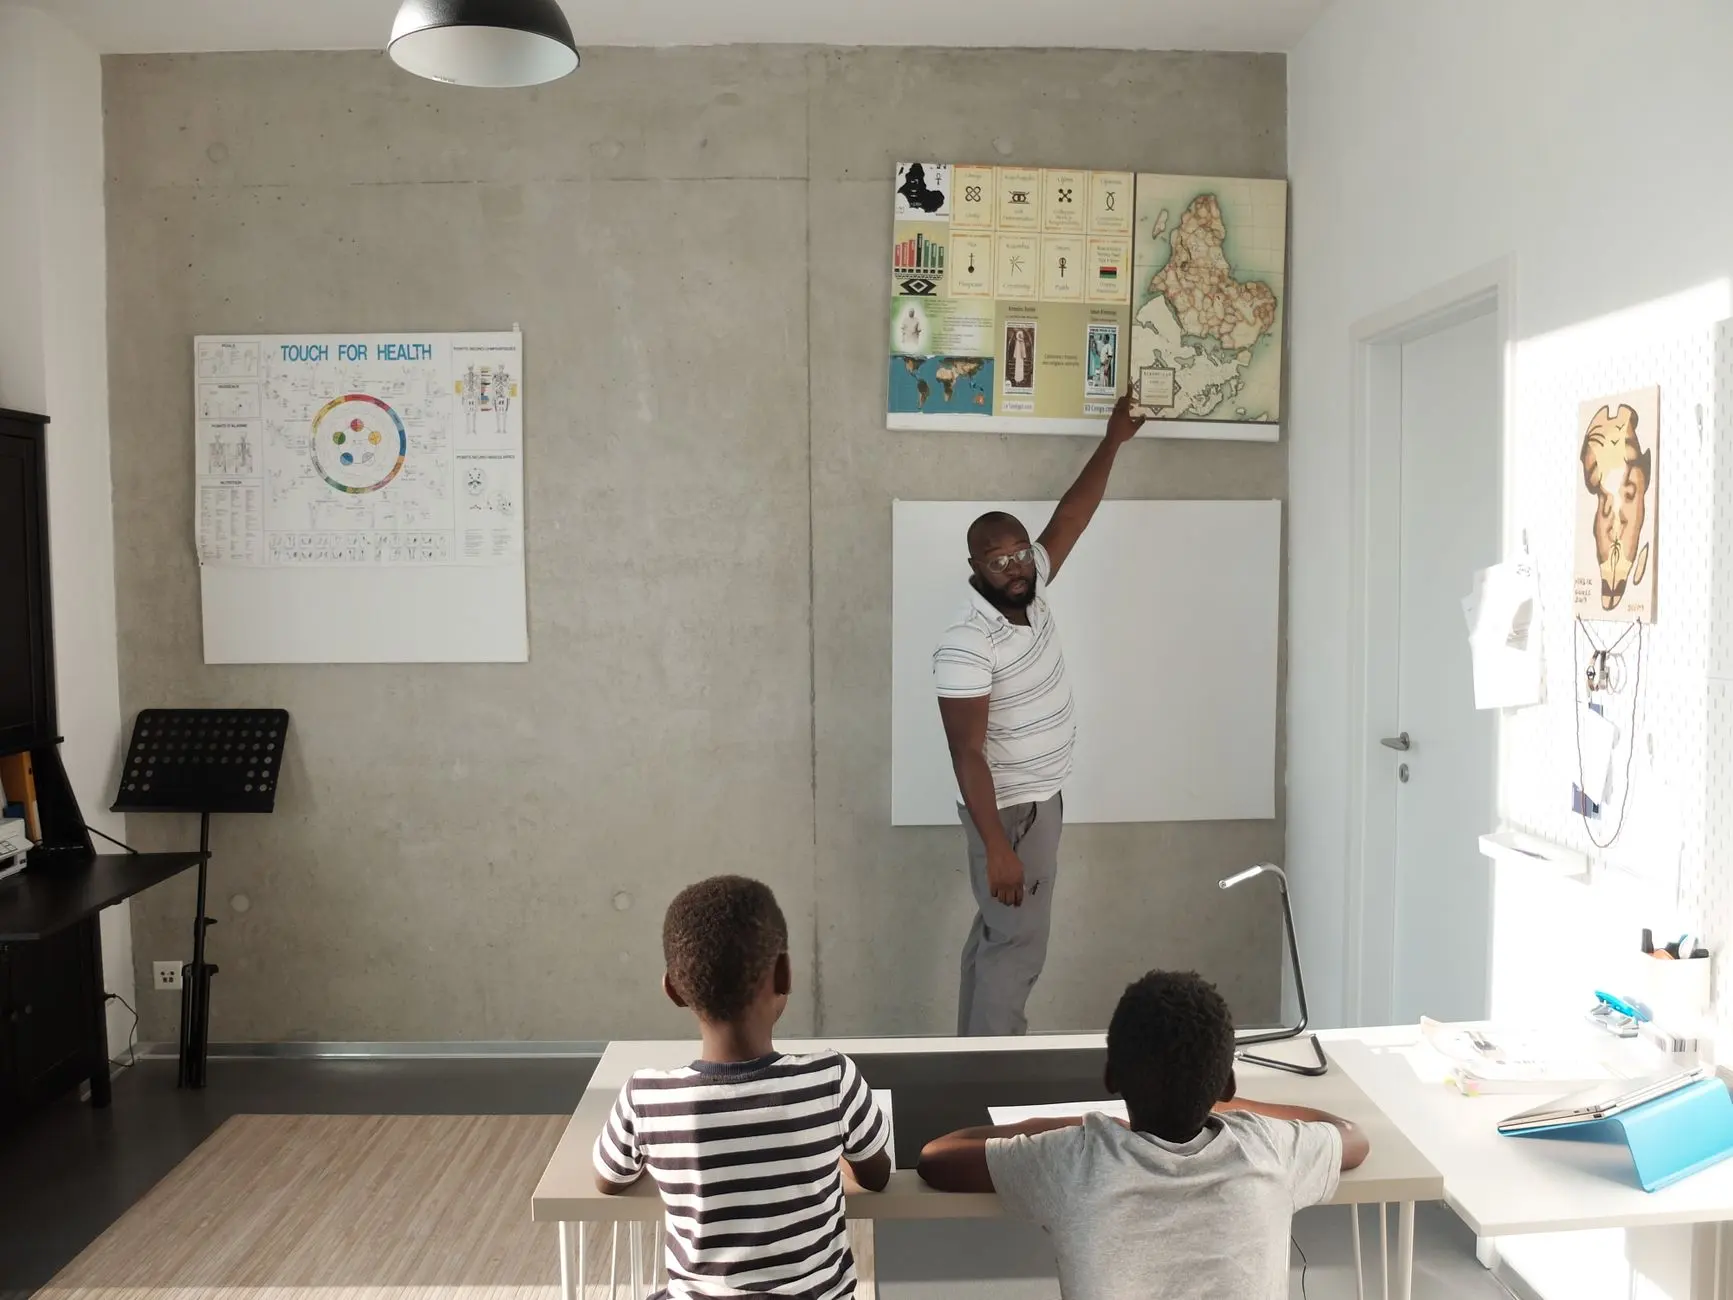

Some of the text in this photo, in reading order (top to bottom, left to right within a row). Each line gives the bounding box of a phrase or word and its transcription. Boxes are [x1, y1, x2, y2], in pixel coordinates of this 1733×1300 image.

[280, 343, 432, 362] TOUCH FOR HEALTH
